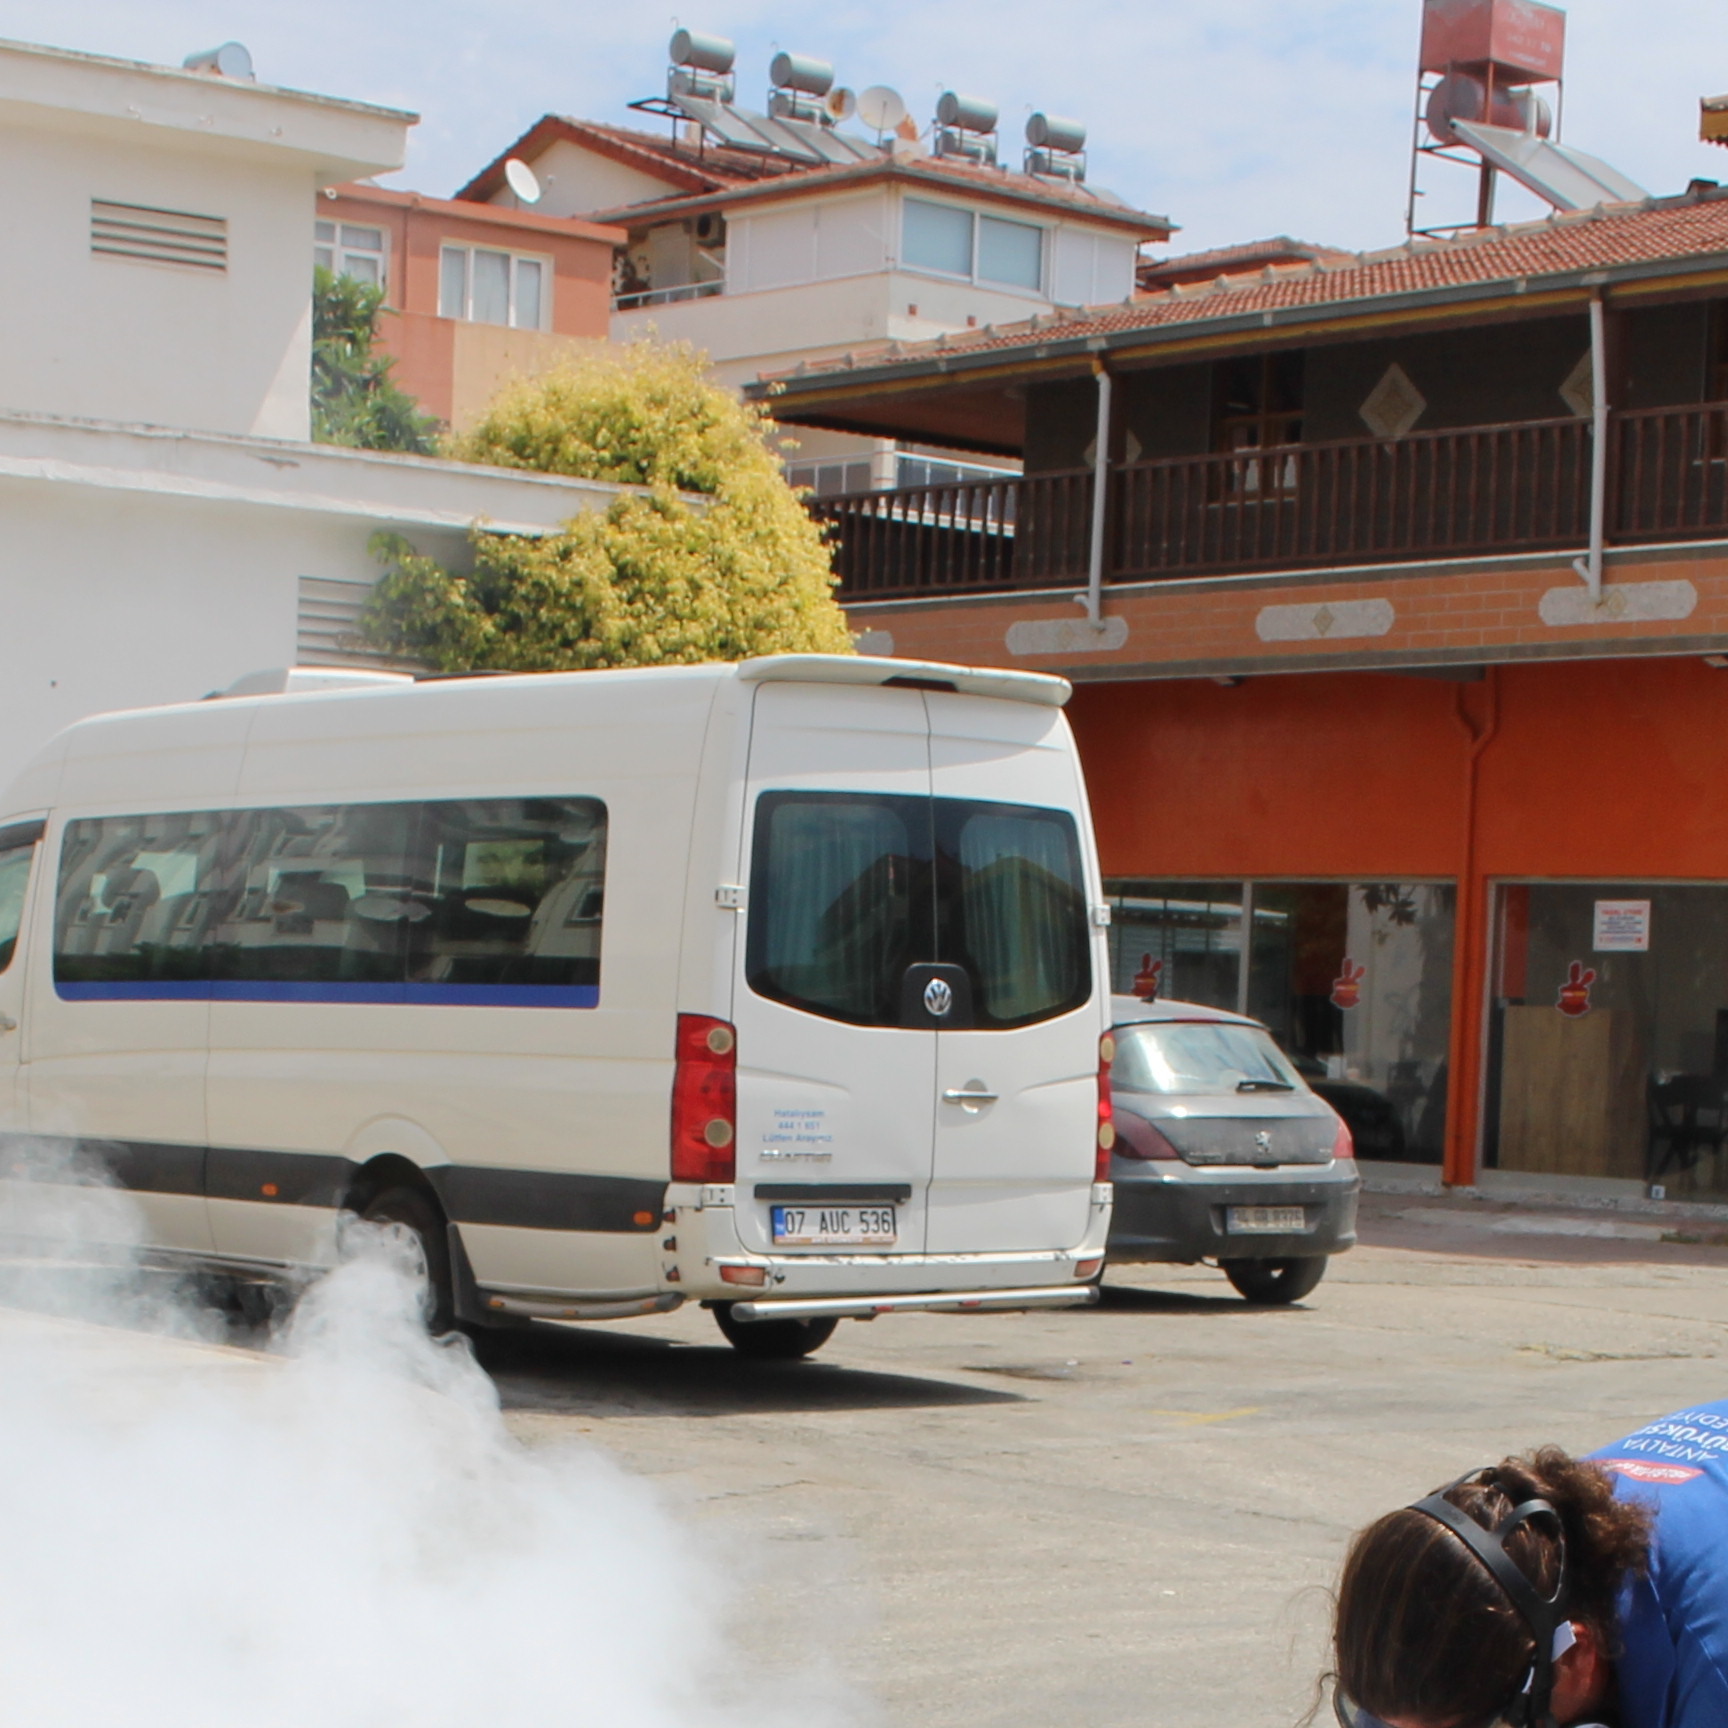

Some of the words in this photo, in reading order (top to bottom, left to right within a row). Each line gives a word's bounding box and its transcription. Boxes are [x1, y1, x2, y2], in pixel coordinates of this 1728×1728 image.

[785, 1211, 805, 1234] 07
[820, 1211, 850, 1234] AUC
[860, 1211, 891, 1234] 536
[1622, 1438, 1719, 1462] ANTALYA
